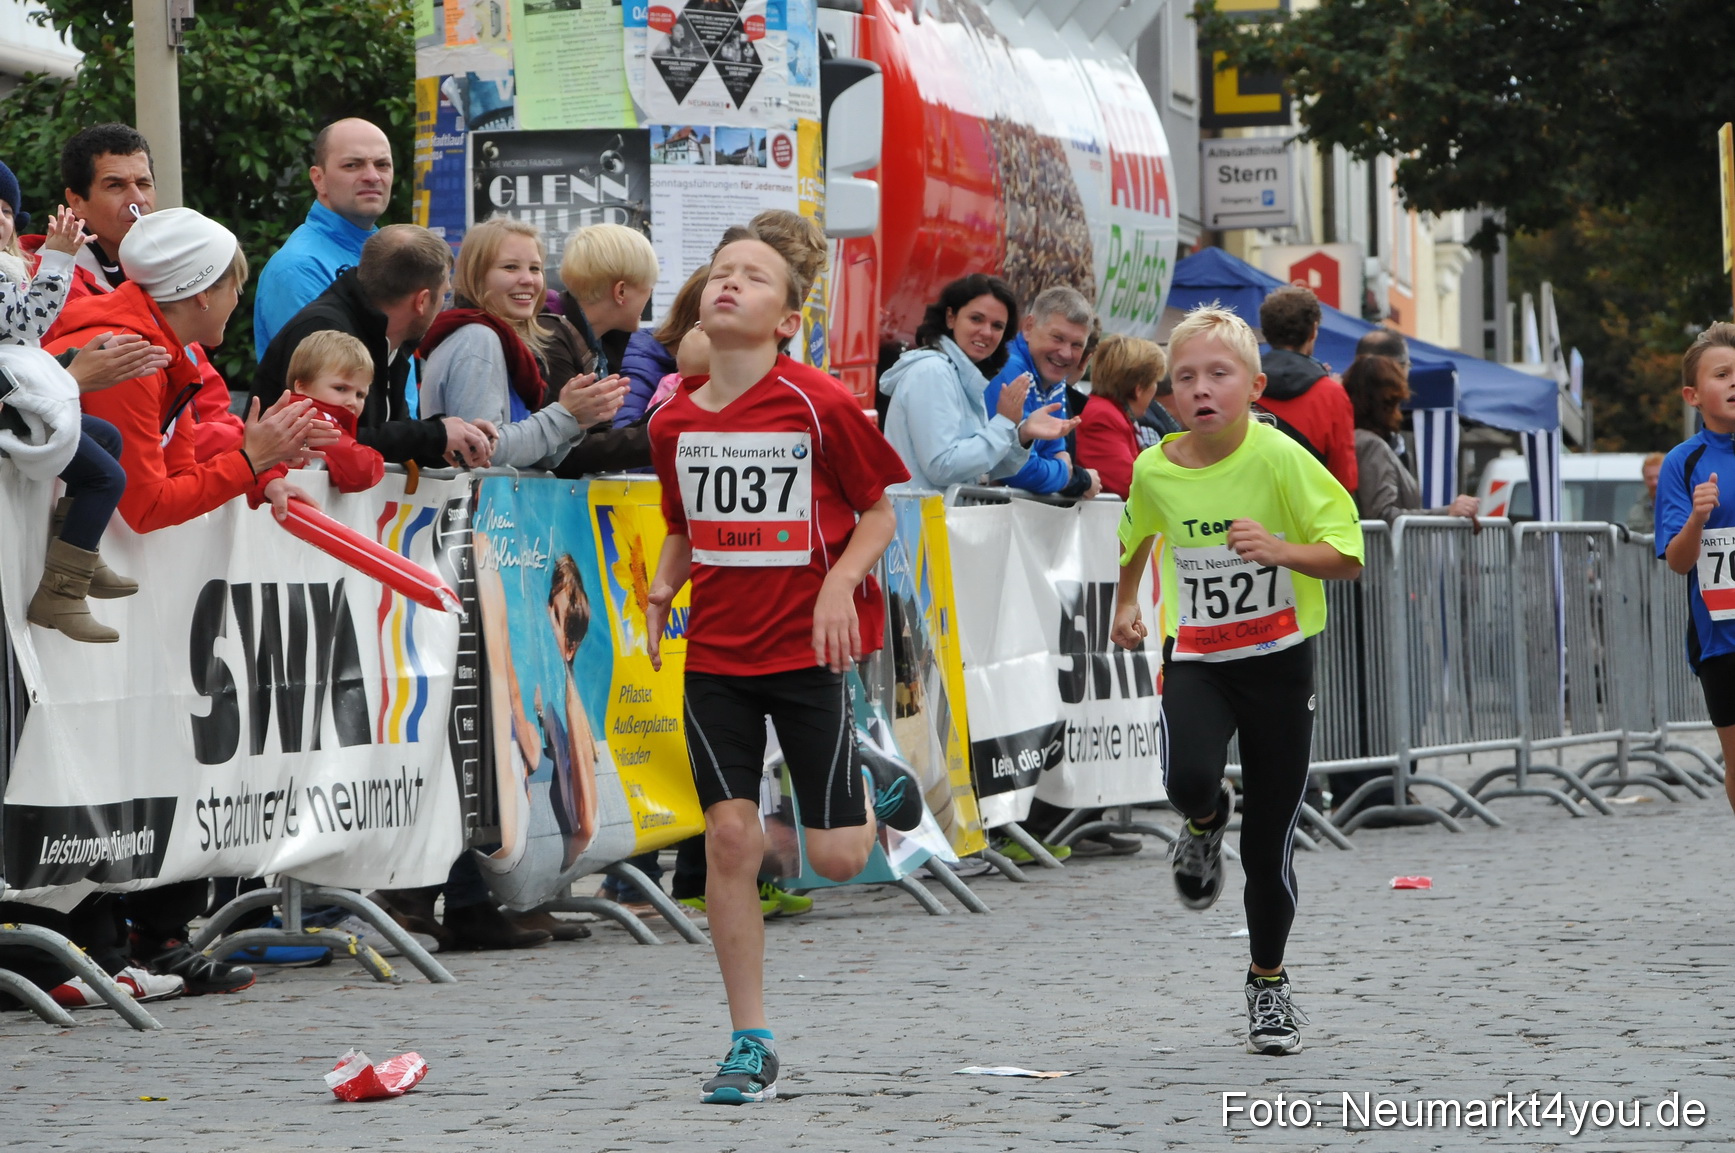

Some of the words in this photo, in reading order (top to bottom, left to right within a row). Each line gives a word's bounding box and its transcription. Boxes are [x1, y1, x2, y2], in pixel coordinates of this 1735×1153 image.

[489, 160, 501, 168] THE
[502, 159, 527, 168] WORLD
[528, 158, 563, 167] FAMOUS
[1102, 115, 1171, 219] AVIA
[1218, 164, 1278, 184] Stern
[488, 173, 630, 208] GLENN
[740, 180, 753, 190] für
[755, 181, 793, 192] Jedermann
[187, 264, 215, 288] odlo
[1097, 222, 1167, 325] Pellets
[678, 446, 719, 459] PARTL
[721, 446, 787, 459] Neumarkt
[688, 465, 799, 514] 7037
[717, 528, 762, 547] Lauri
[1175, 557, 1204, 572] PARTL
[1183, 565, 1279, 620] 7527
[1235, 619, 1274, 639] Odin
[618, 685, 653, 704] Pflaster
[612, 713, 679, 740] Außenplatten
[1018, 748, 1042, 773] die
[306, 765, 424, 834] neumarkt
